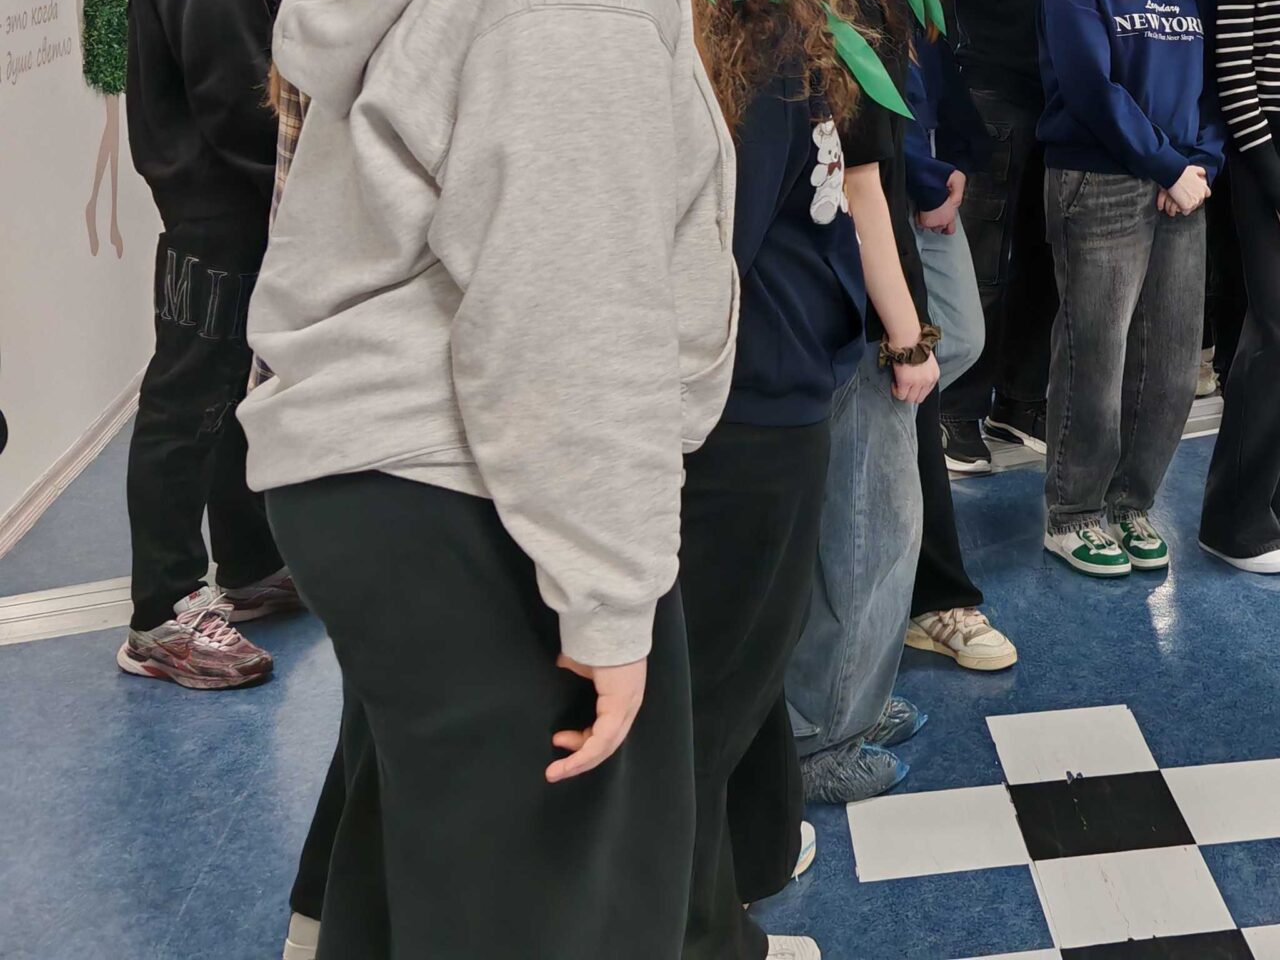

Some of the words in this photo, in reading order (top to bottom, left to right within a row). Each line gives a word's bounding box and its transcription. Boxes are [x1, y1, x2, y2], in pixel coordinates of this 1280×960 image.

[6, 11, 28, 34] это
[1114, 13, 1160, 32] NEW
[6, 50, 33, 85] душе
[37, 36, 72, 67] светло
